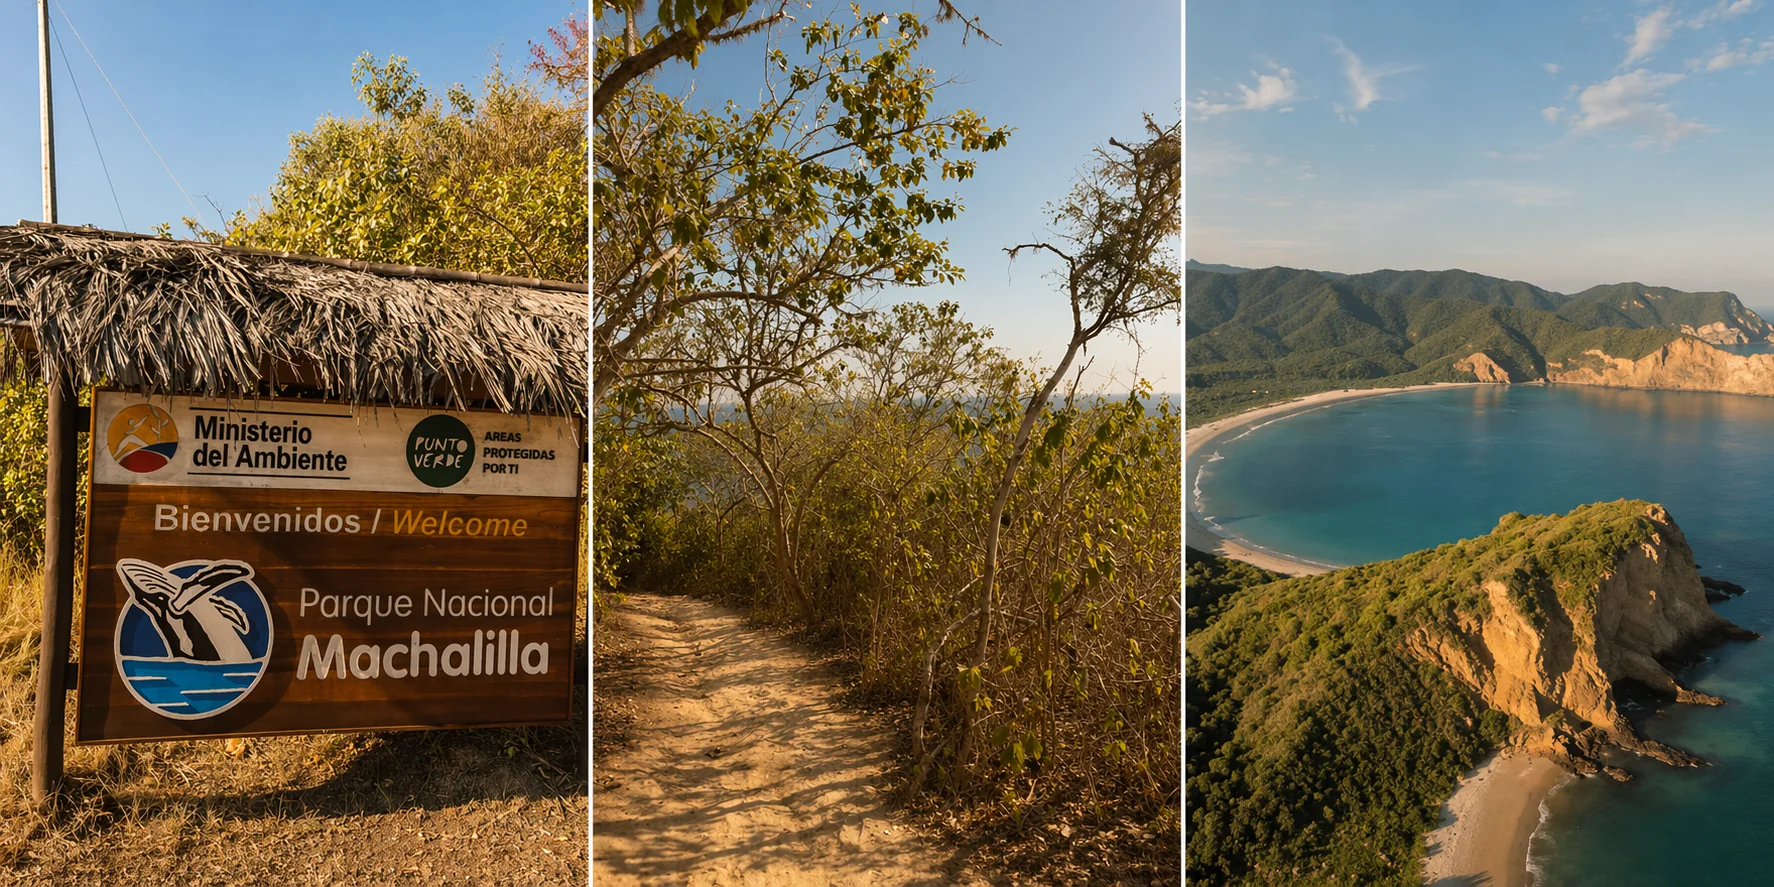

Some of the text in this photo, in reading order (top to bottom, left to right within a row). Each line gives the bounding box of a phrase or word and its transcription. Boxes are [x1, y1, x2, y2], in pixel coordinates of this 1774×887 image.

[194, 415, 312, 445] Ministerio
[484, 431, 522, 443] AREAS
[415, 436, 468, 453] PUNTO
[483, 447, 555, 461] PROTEGIDAS
[192, 442, 347, 472] del Ambiente
[413, 452, 464, 469] VERDE
[482, 463, 519, 475] POR TI
[154, 503, 528, 537] Bienvenidos / Welcome
[299, 586, 553, 626] Parque Nacional
[296, 629, 549, 680] Machalilla
